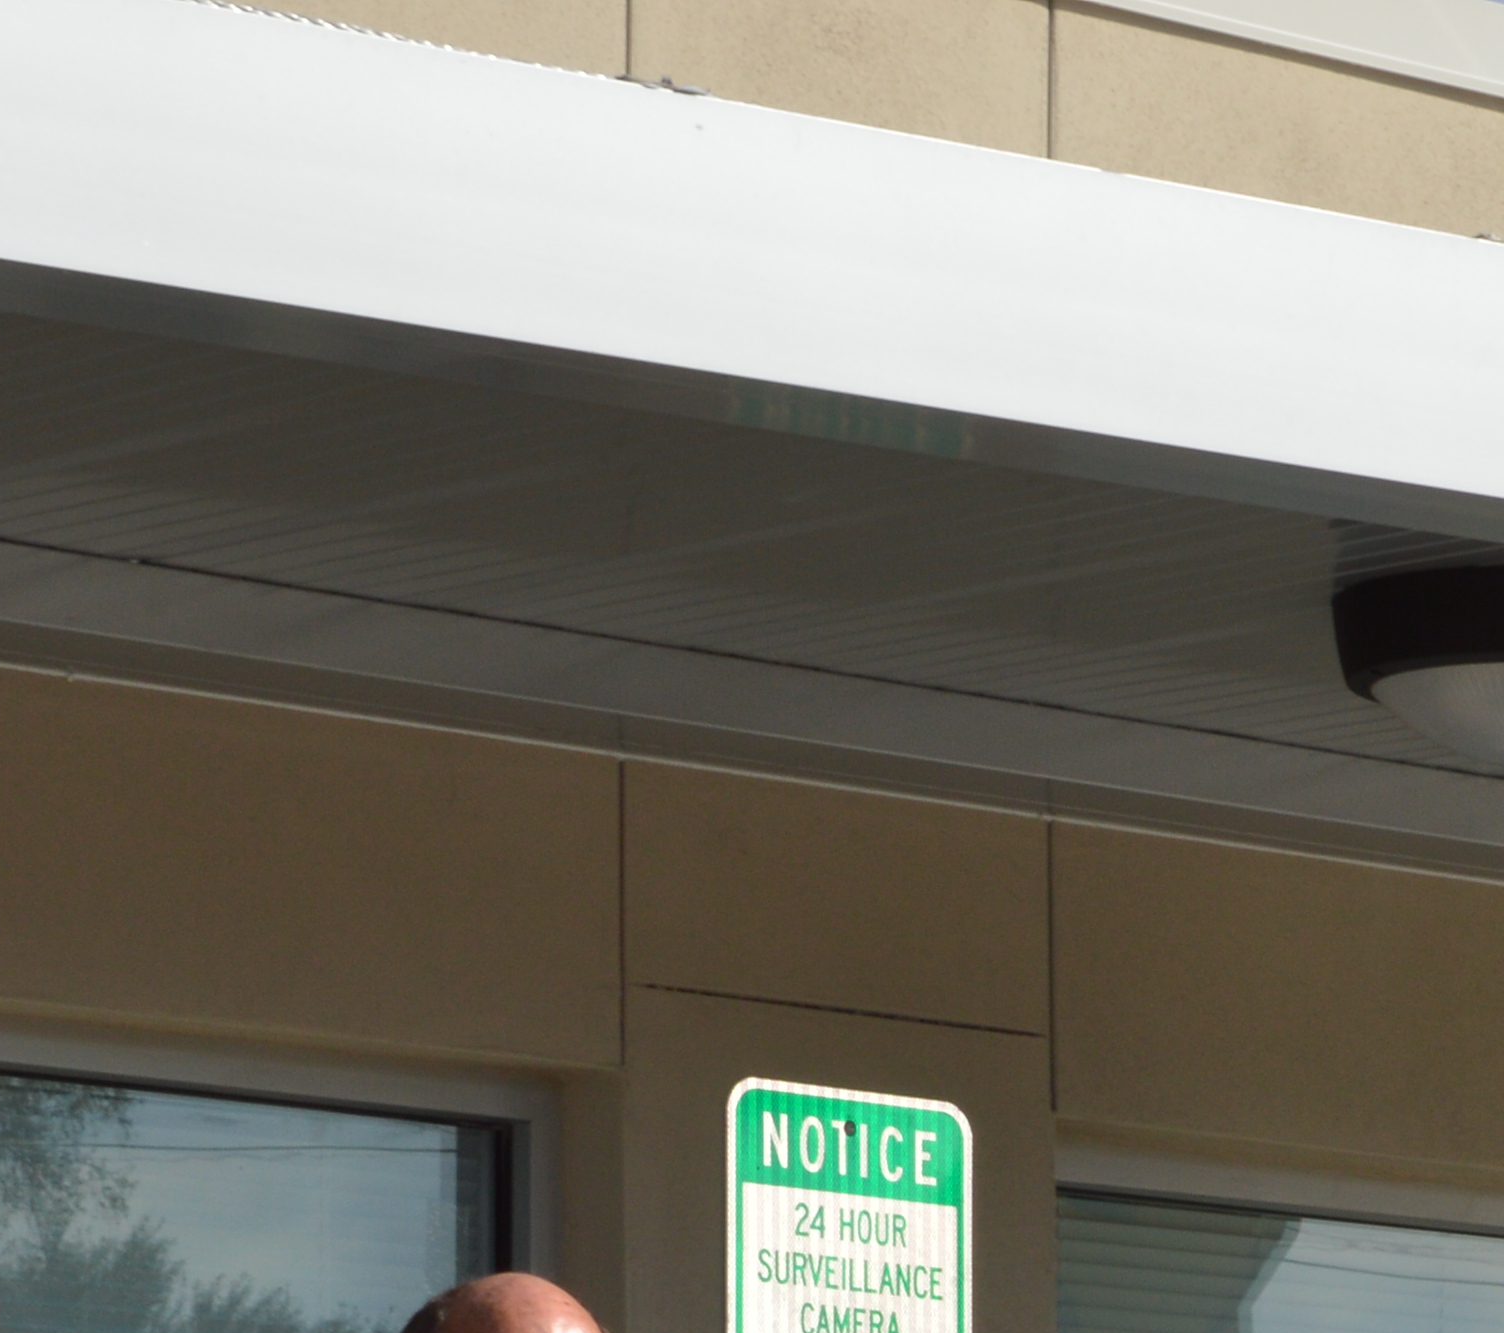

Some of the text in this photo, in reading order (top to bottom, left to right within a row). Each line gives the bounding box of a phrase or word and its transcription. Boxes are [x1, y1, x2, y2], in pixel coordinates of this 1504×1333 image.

[762, 1111, 938, 1186] NOTICE
[794, 1202, 907, 1248] 24 HOUR
[757, 1247, 944, 1301] SURVEILLANCE
